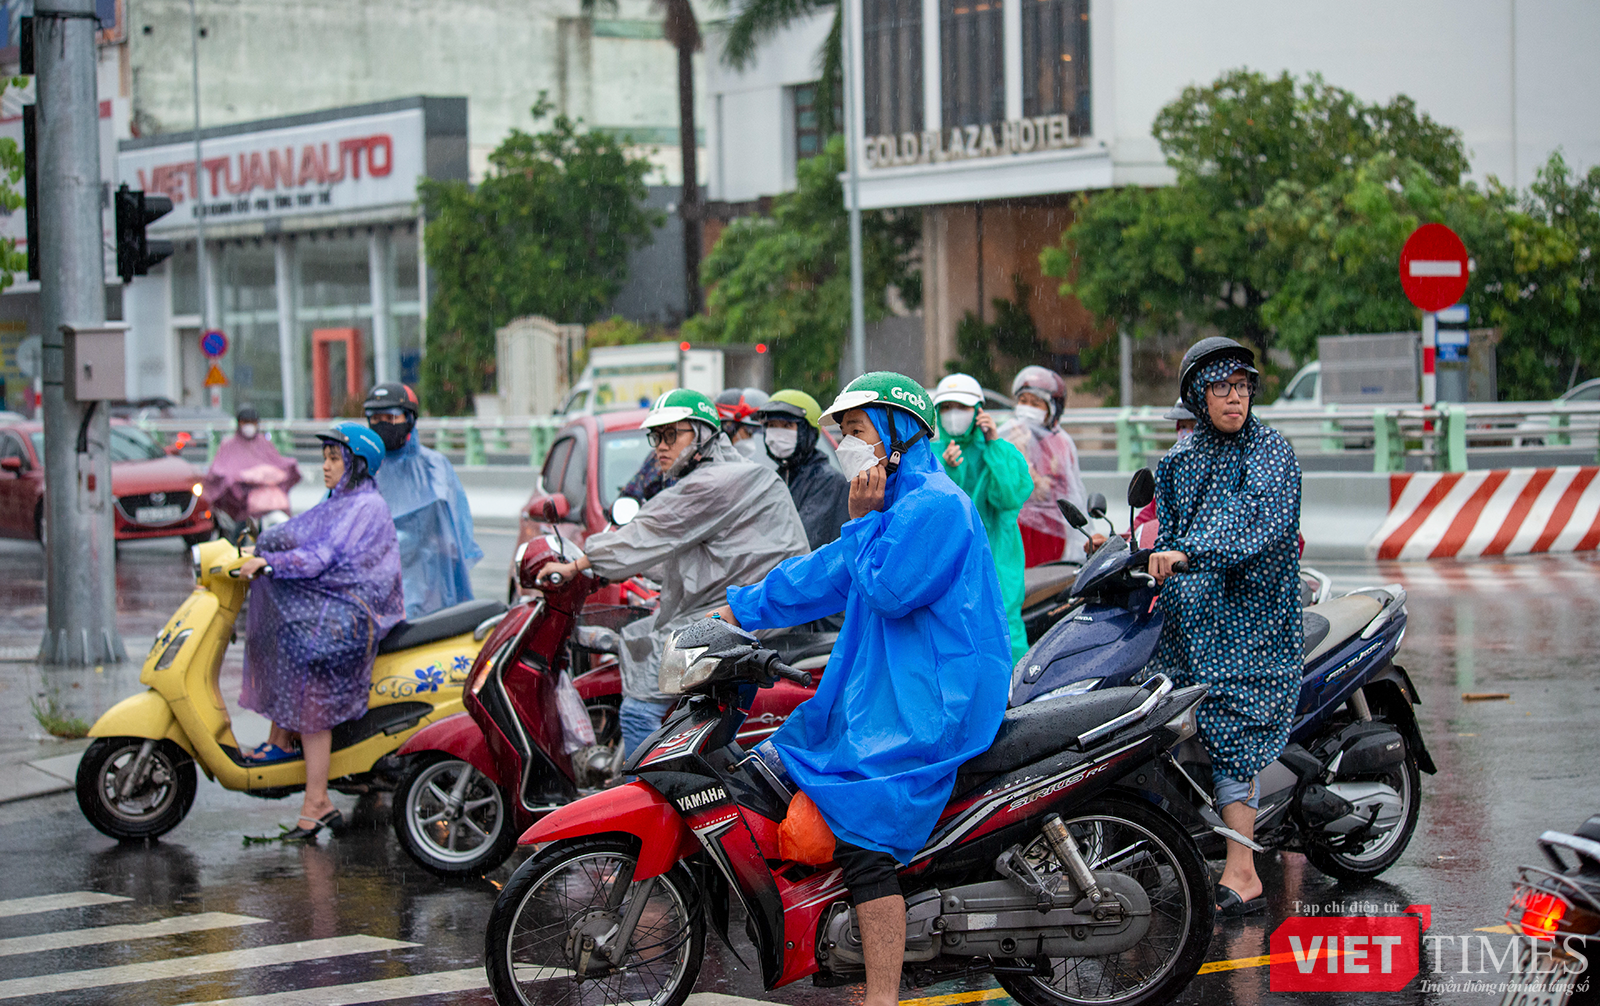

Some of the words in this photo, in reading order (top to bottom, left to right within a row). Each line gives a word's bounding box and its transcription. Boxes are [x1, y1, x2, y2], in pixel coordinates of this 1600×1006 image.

[864, 132, 919, 167] GOLD
[921, 123, 998, 163] PLAZA
[1002, 114, 1077, 154] HOTEL
[891, 386, 926, 410] Grab
[676, 785, 727, 812] YAMAHA
[1006, 768, 1088, 813] SIRIUS
